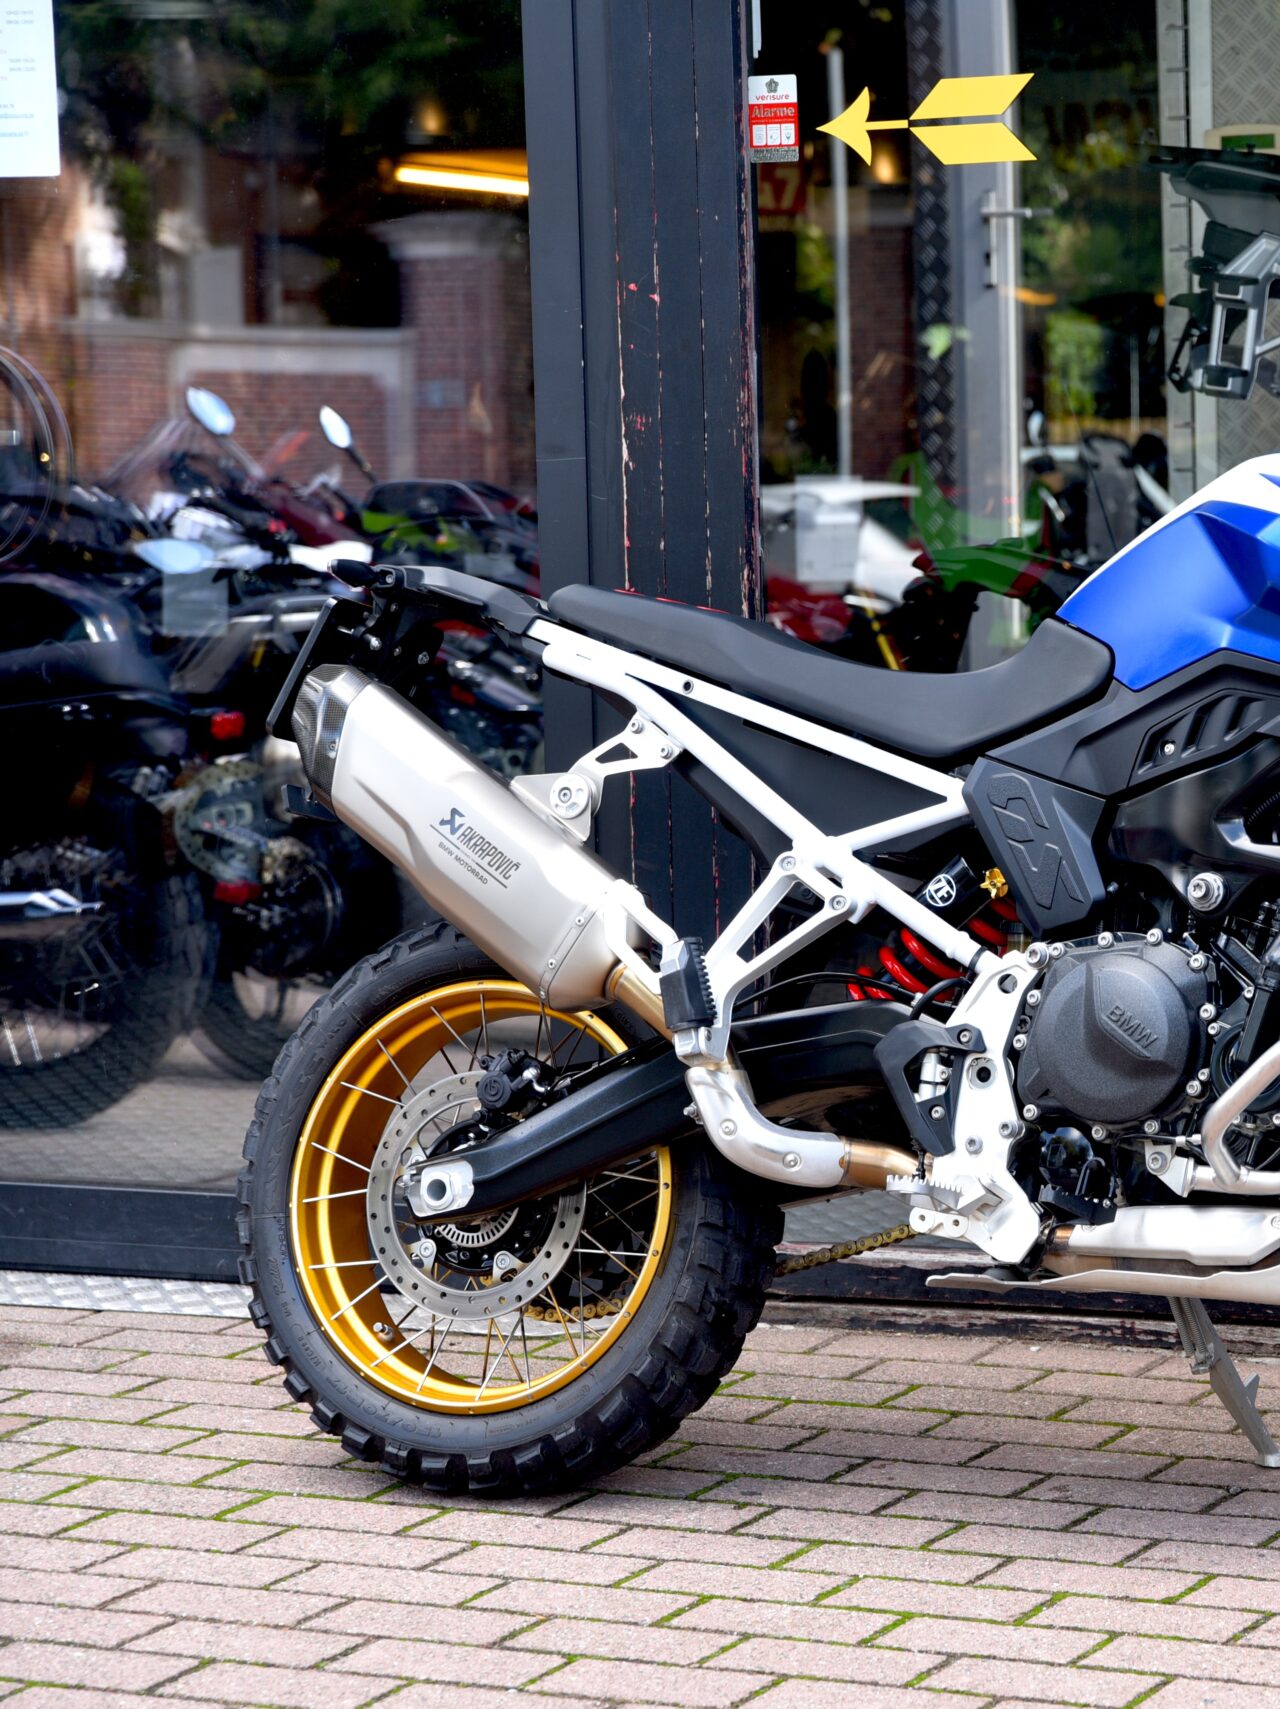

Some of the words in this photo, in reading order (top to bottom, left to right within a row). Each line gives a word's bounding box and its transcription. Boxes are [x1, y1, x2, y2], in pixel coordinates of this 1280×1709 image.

[752, 105, 795, 118] Alarme
[438, 841, 455, 858] BMW
[453, 854, 489, 886] MOTORRAD
[456, 825, 521, 881] AKRAPOVIČ
[1106, 1005, 1159, 1050] BMW
